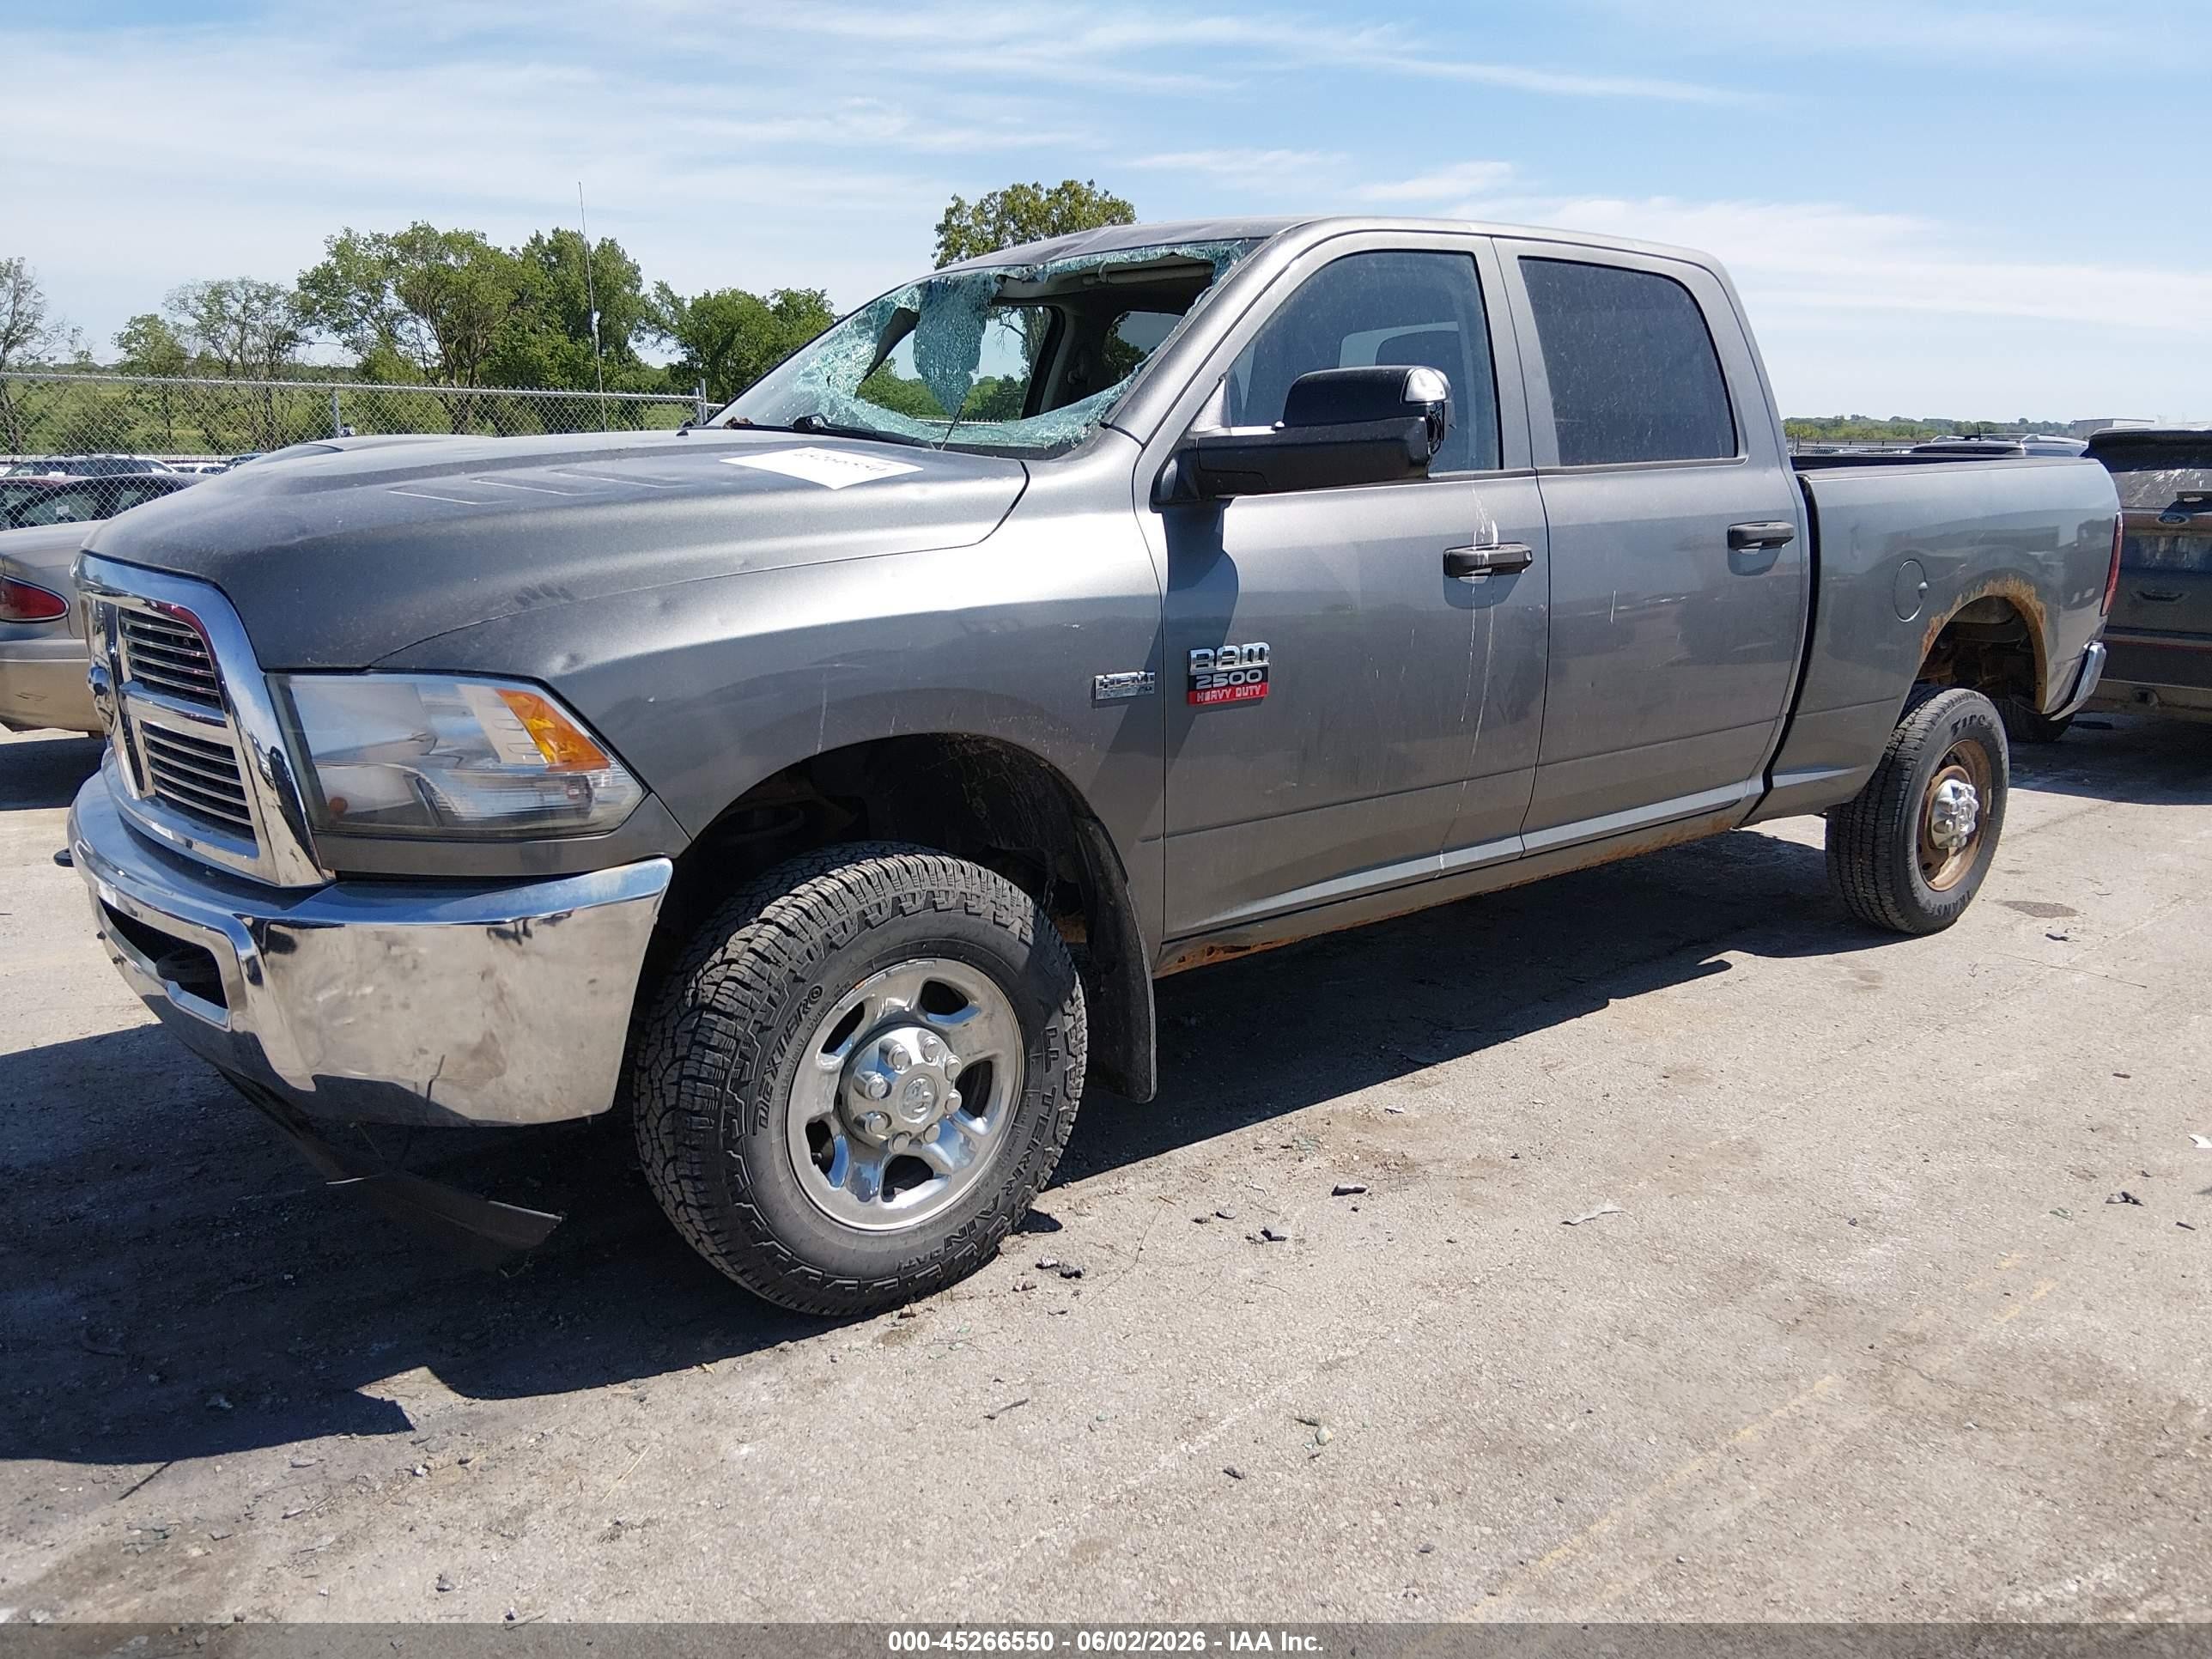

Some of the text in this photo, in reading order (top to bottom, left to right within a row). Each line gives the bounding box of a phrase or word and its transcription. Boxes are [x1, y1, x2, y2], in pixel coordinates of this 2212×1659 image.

[1189, 641, 1270, 676] RAM
[1195, 669, 1263, 690] 2500
[1196, 684, 1262, 702] HEAVY DUTY
[752, 984, 823, 1136] DEXTERO
[945, 1085, 1058, 1248] TERRAIN
